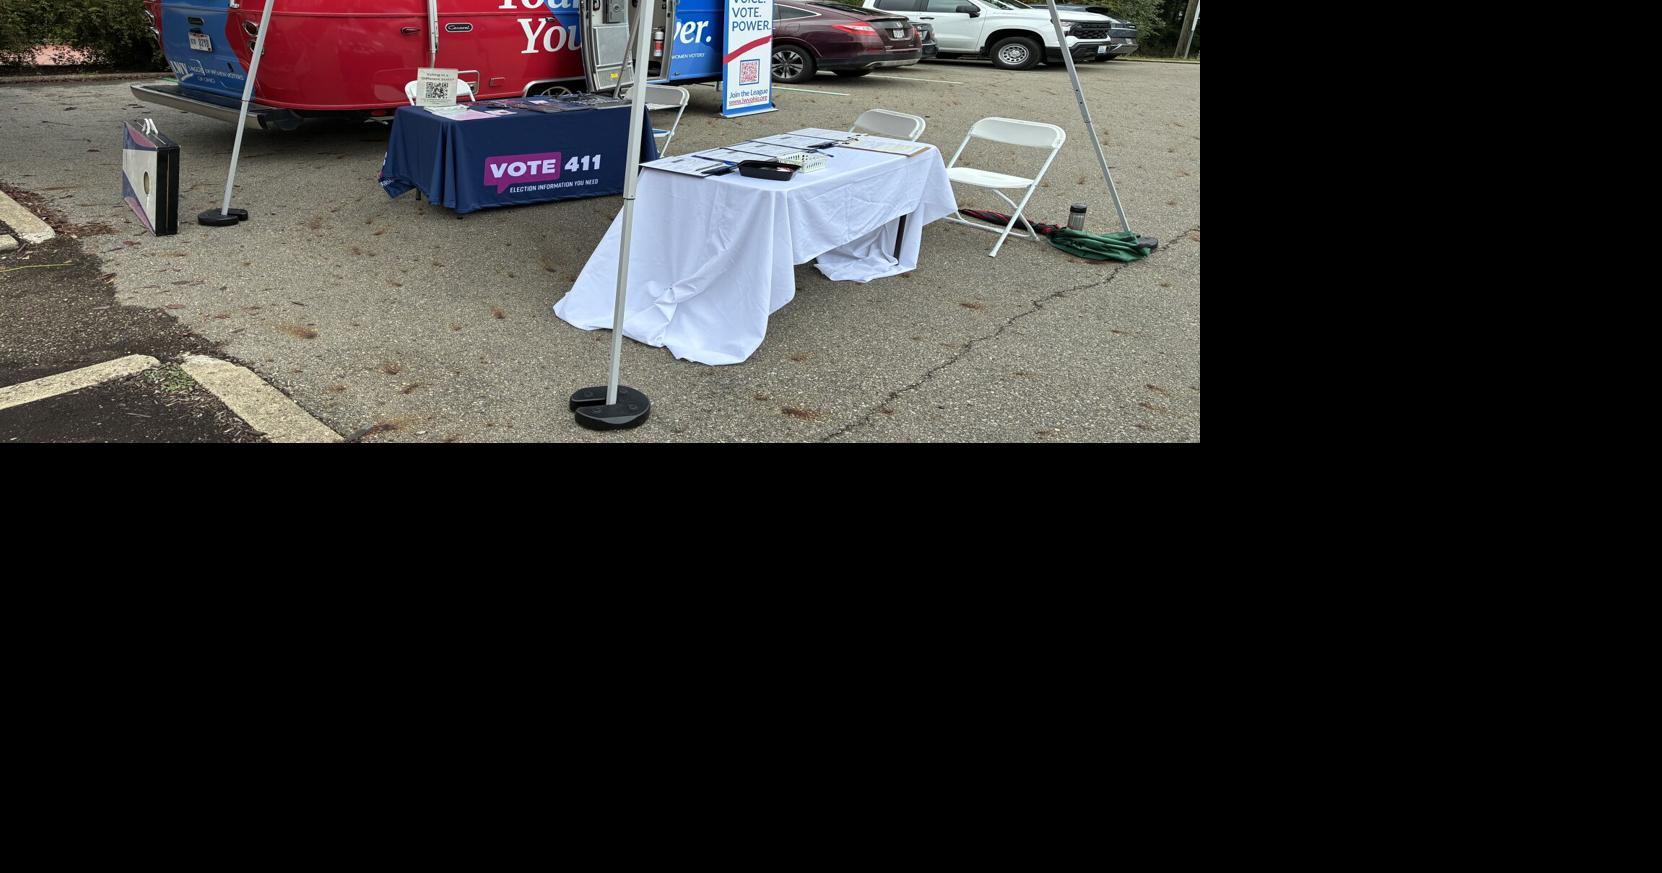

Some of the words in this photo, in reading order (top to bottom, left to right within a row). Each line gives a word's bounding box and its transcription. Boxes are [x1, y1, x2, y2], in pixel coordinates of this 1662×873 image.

[732, 7, 761, 18] VOTE.
[732, 20, 772, 31] POWER.
[730, 91, 740, 99] Join
[750, 88, 768, 96] League
[490, 159, 556, 178] VOTE
[564, 154, 601, 172] 411
[509, 185, 537, 193] ELECTION
[537, 181, 574, 190] INFORMATION
